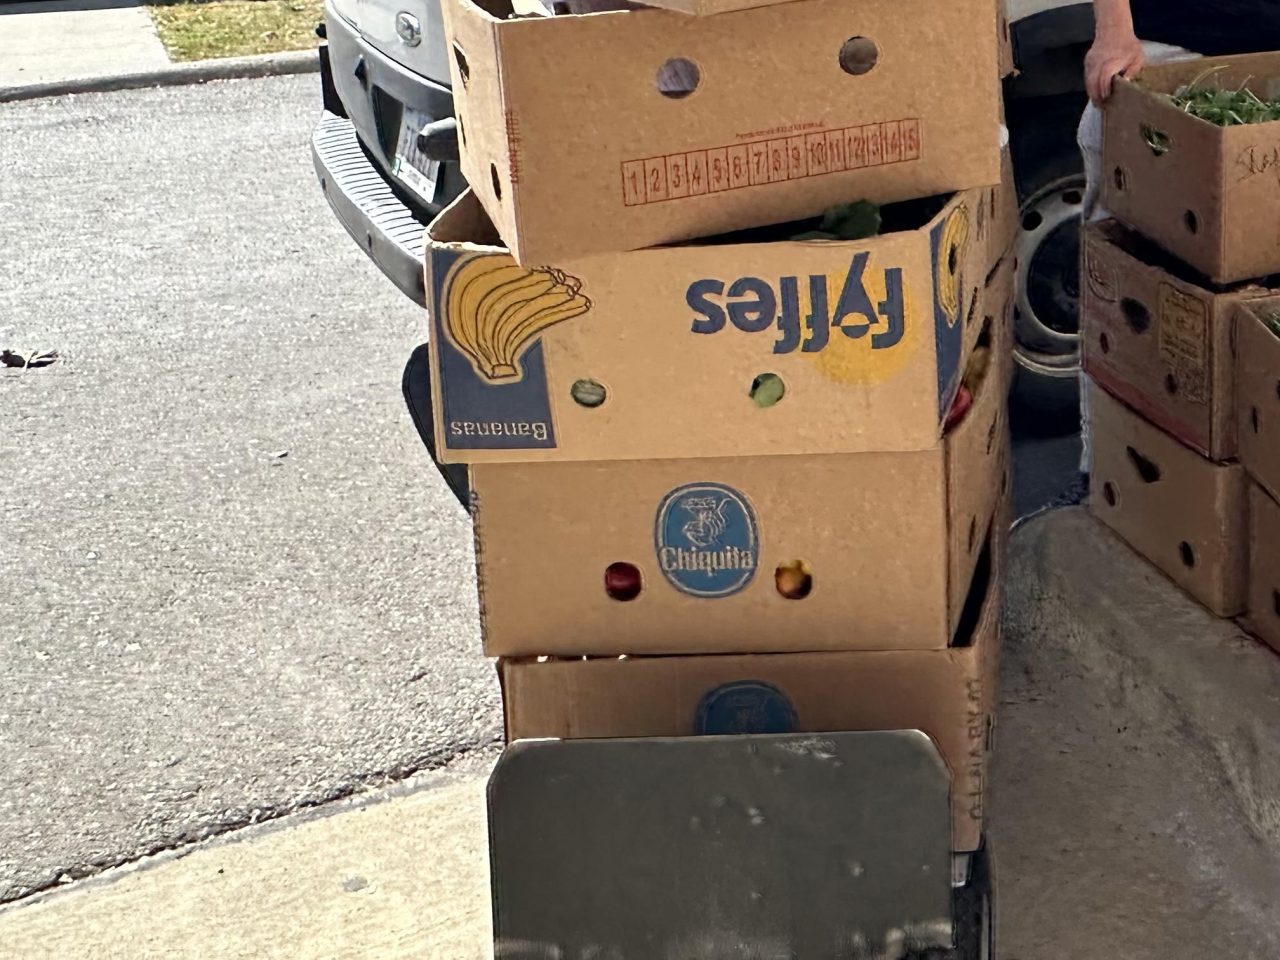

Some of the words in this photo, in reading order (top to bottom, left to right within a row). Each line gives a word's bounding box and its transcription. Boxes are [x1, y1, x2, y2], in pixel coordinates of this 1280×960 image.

[630, 171, 638, 195] 1
[651, 168, 661, 193] 2
[672, 164, 681, 188] 3
[754, 151, 763, 175] 7
[685, 251, 904, 355] fyffes
[451, 421, 548, 441] Bananas
[661, 545, 754, 577] Chiquita
